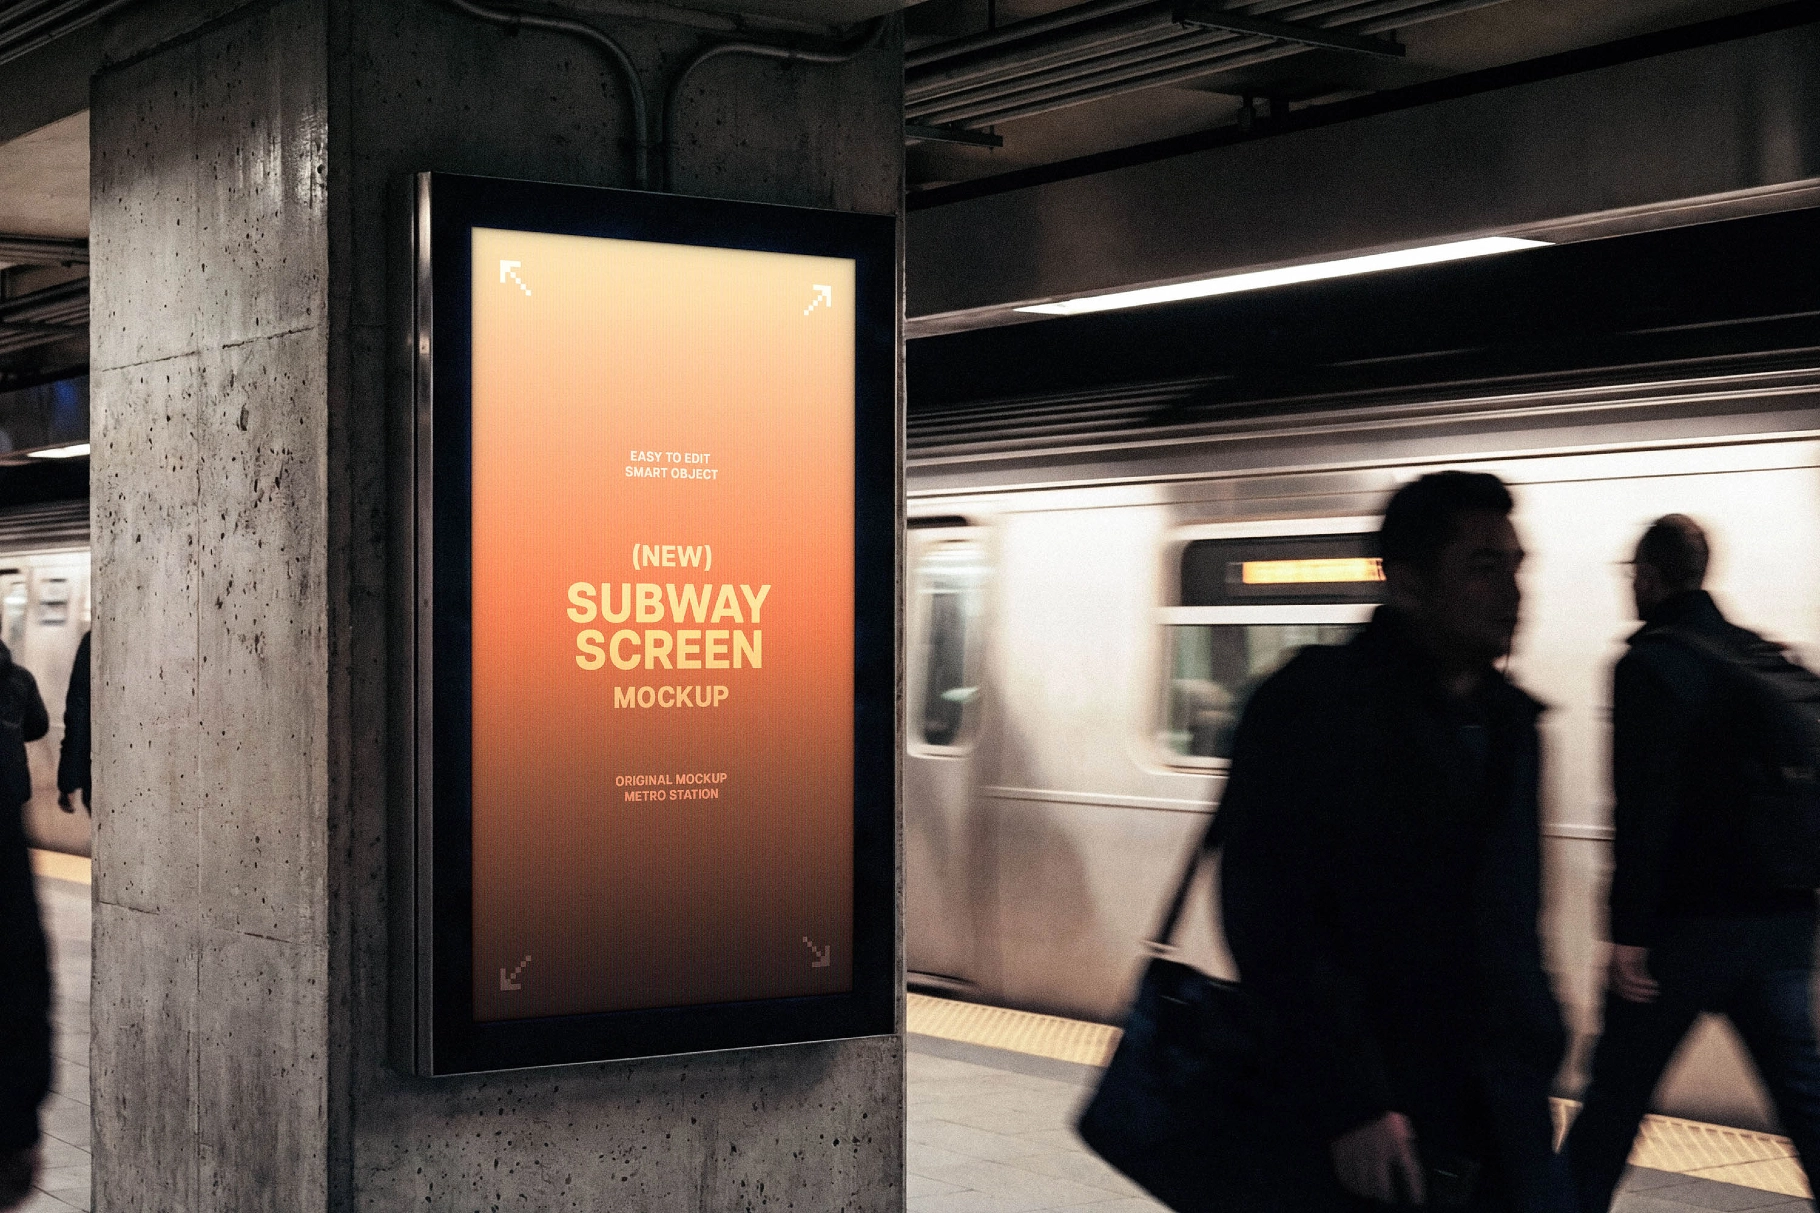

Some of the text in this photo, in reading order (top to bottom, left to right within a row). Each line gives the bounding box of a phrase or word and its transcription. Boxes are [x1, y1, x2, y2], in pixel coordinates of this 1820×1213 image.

[630, 450, 711, 464] EASY TO EDIT
[625, 466, 719, 480] SMART OBJECT
[632, 543, 712, 571] (NEW)
[567, 582, 772, 623] SUBWAY
[576, 629, 762, 670] SCREEN
[614, 685, 729, 708] MOCKUP
[615, 772, 727, 787] ORIGINAL MOCKUP
[624, 788, 719, 802] METRO STATION
